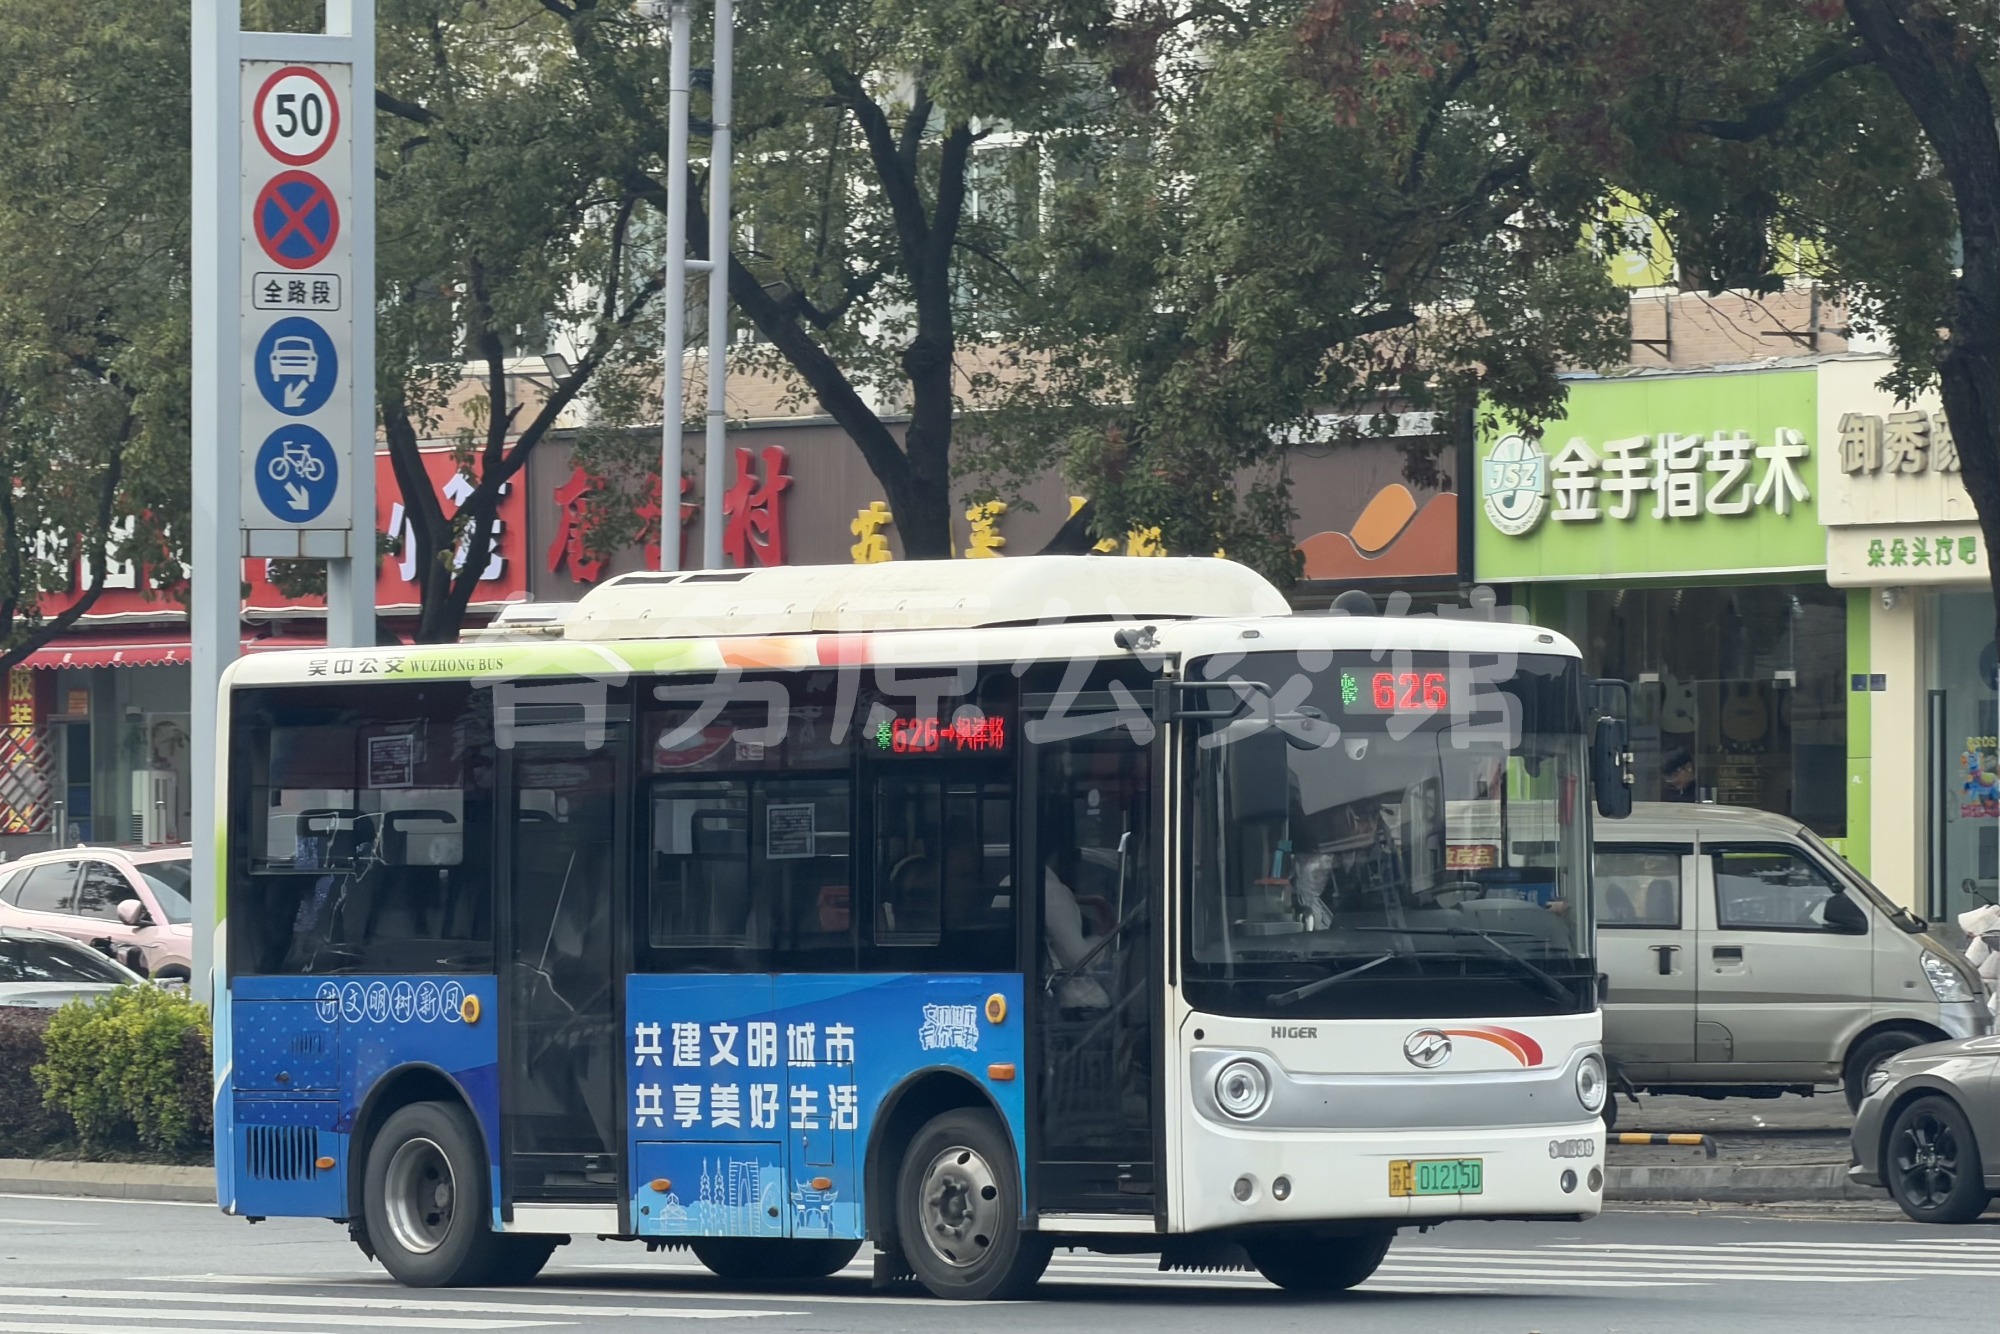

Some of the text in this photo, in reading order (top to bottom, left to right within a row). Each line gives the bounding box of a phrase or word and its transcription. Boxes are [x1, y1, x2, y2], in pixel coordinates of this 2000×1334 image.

[275, 92, 323, 138] 50
[264, 280, 331, 304] 全路段
[1489, 462, 1538, 490] JSZ
[1549, 427, 1811, 521] 金手指艺术
[1867, 536, 1977, 567] 朵朵头疗吧
[308, 656, 504, 677] 吴中公交 WUZHONG BUS
[1372, 672, 1447, 709] 626
[892, 717, 940, 753] 626
[319, 985, 464, 1020] 讲文明树新风
[634, 1022, 855, 1068] 共建文明城市
[1271, 1026, 1318, 1039] HIGER
[635, 1083, 858, 1130] 共享美好生活
